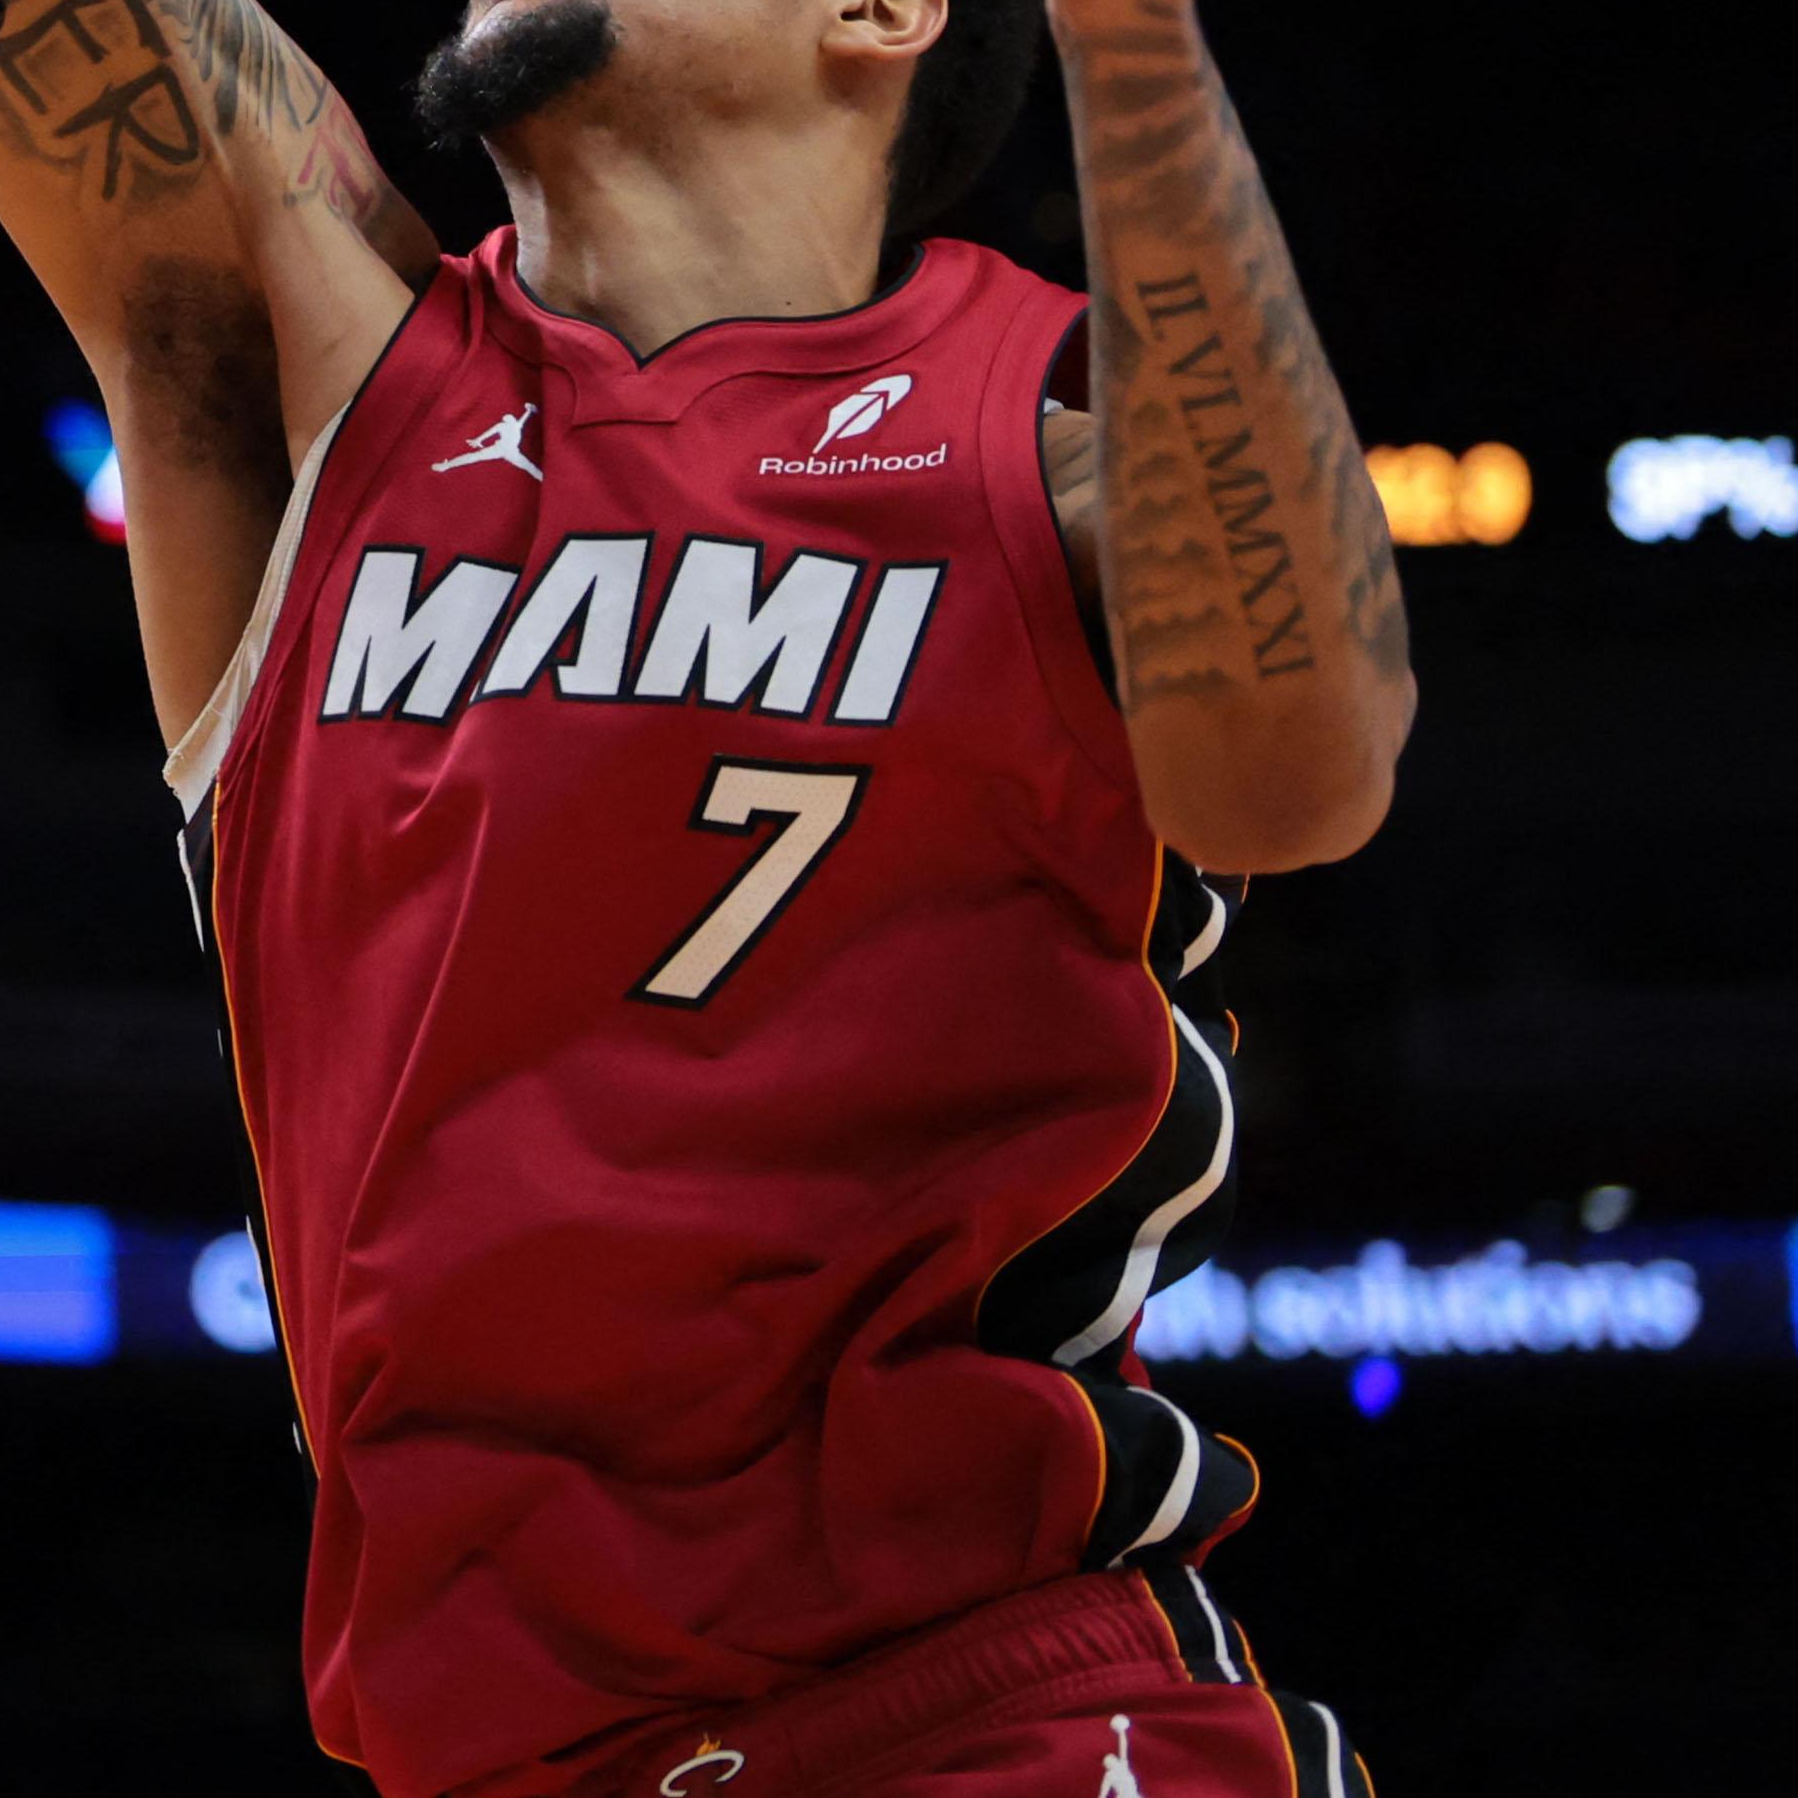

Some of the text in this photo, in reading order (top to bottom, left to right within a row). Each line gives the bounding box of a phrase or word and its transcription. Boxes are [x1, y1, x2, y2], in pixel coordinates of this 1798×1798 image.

[758, 442, 948, 476] Robinhood
[317, 530, 950, 727] MAMI
[623, 754, 874, 1010] 7
[1250, 1238, 1706, 1360] solutions
